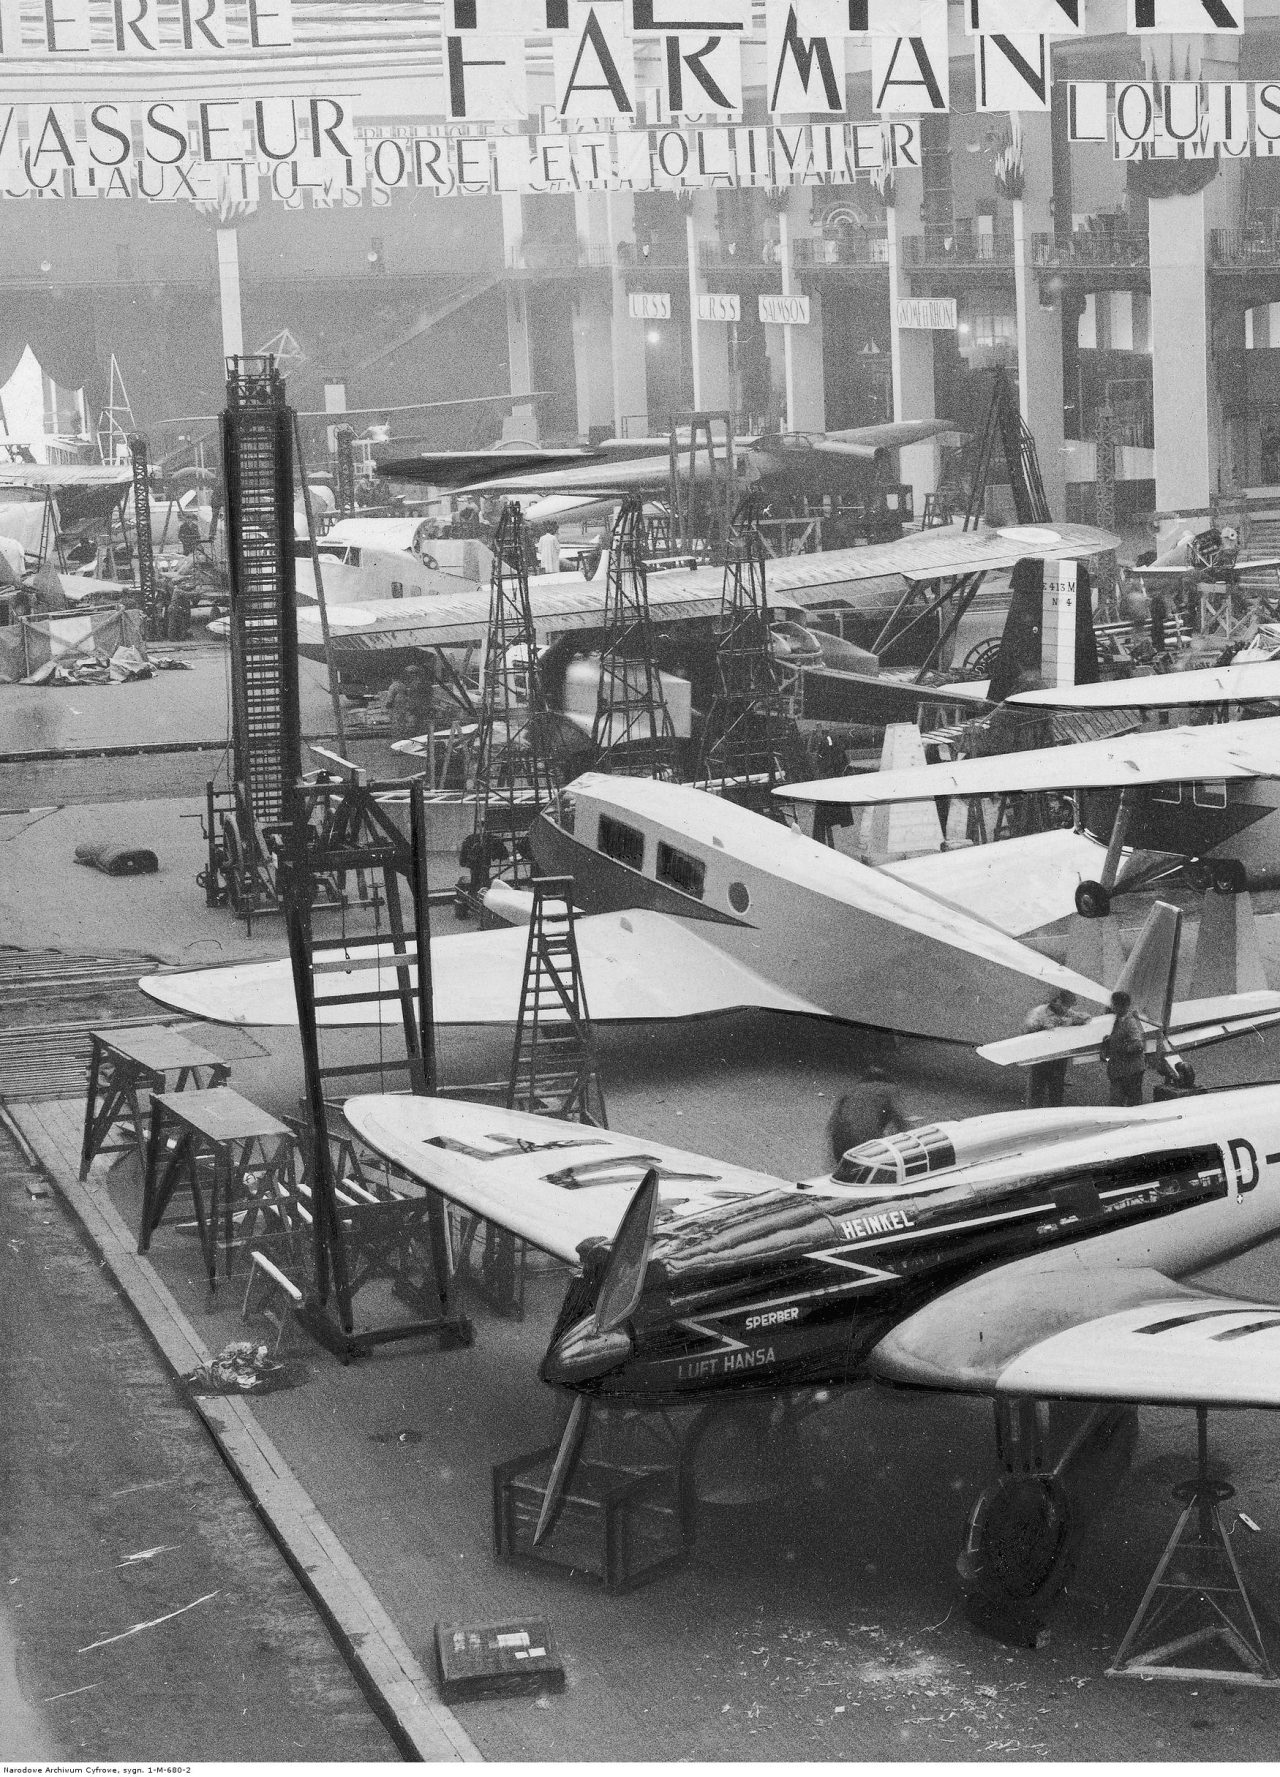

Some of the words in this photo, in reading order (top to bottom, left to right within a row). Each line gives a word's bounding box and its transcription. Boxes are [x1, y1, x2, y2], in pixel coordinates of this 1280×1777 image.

[447, 5, 1047, 118] FARMAN
[543, 143, 605, 182] ET
[658, 122, 920, 177] OLIVIER
[632, 294, 668, 318] URSS
[697, 295, 737, 321] URSS
[762, 296, 807, 322] SALMSON
[840, 1210, 916, 1240] HEINKEL
[745, 1306, 800, 1331] SPERBER
[678, 1357, 719, 1380] LUFT
[723, 1346, 777, 1372] HANSA
